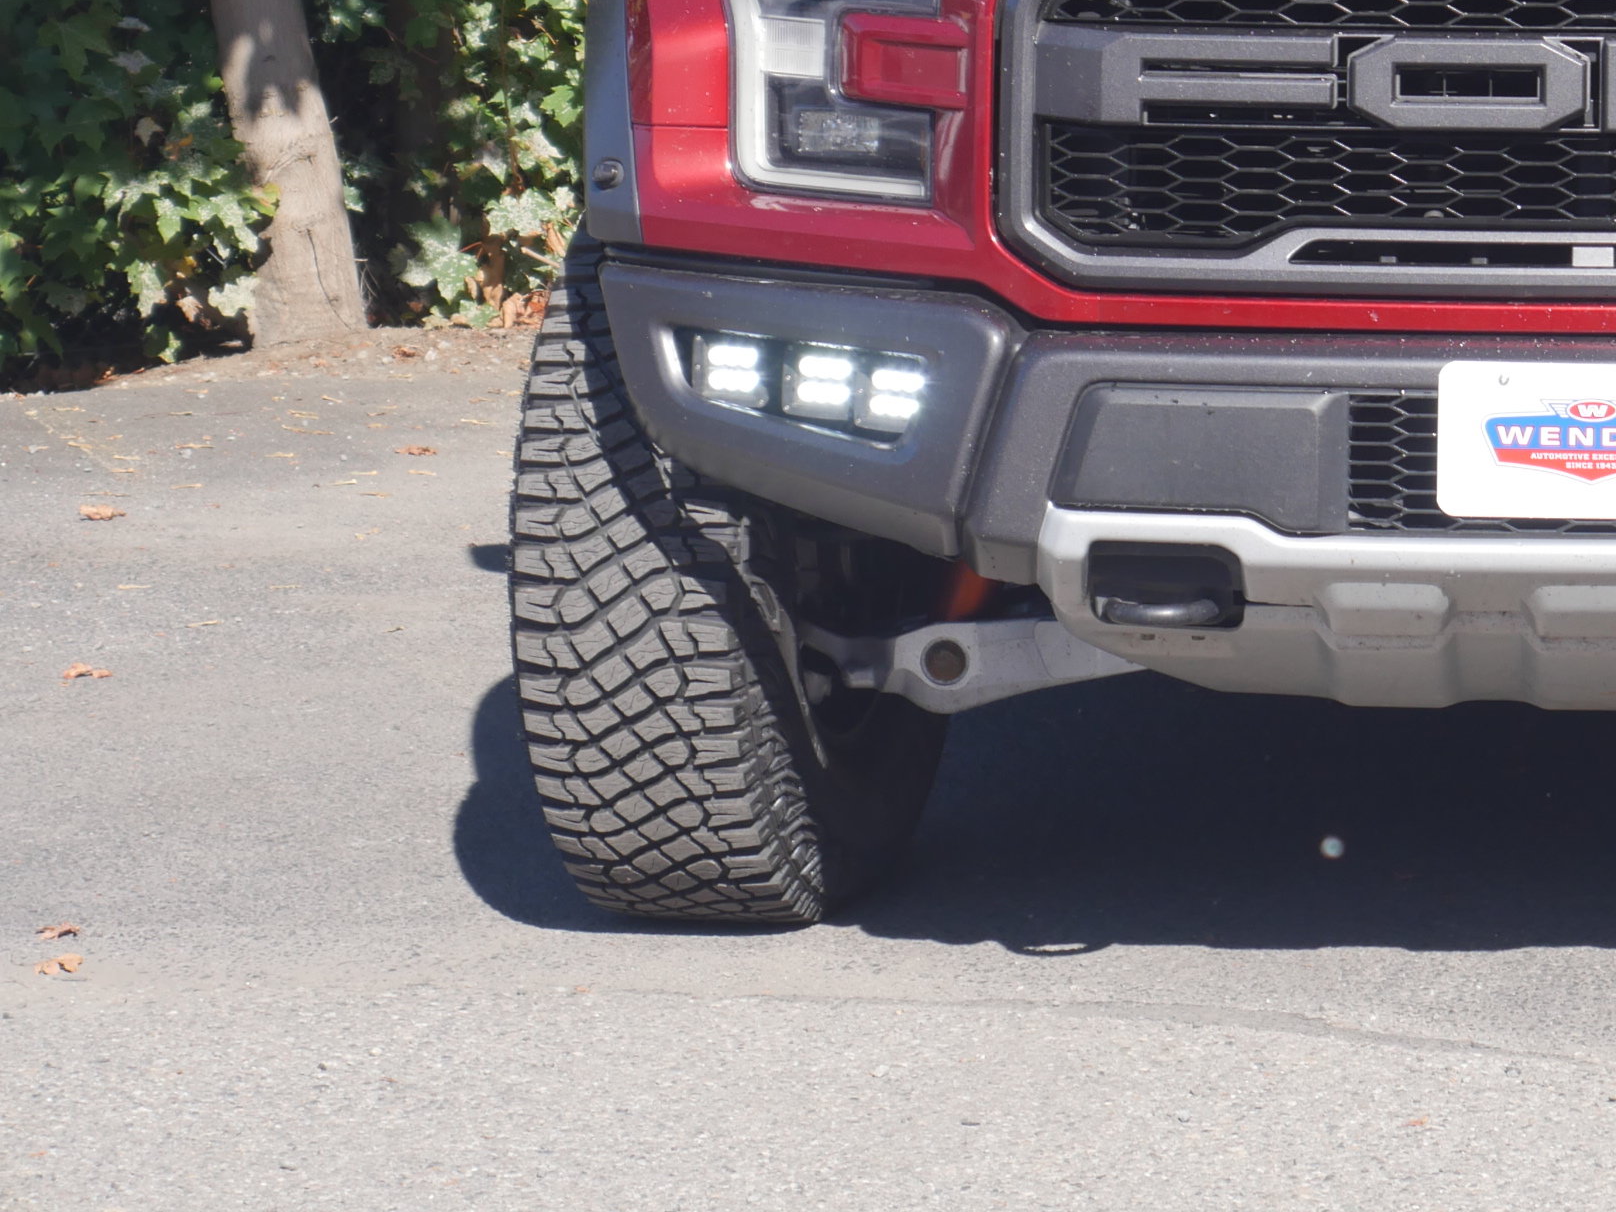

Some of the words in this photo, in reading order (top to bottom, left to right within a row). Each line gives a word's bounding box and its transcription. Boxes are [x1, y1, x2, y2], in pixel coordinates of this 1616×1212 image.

[1578, 404, 1608, 418] W
[1530, 452, 1590, 461] AUTOMOTIVE
[1565, 462, 1593, 470] SINCE
